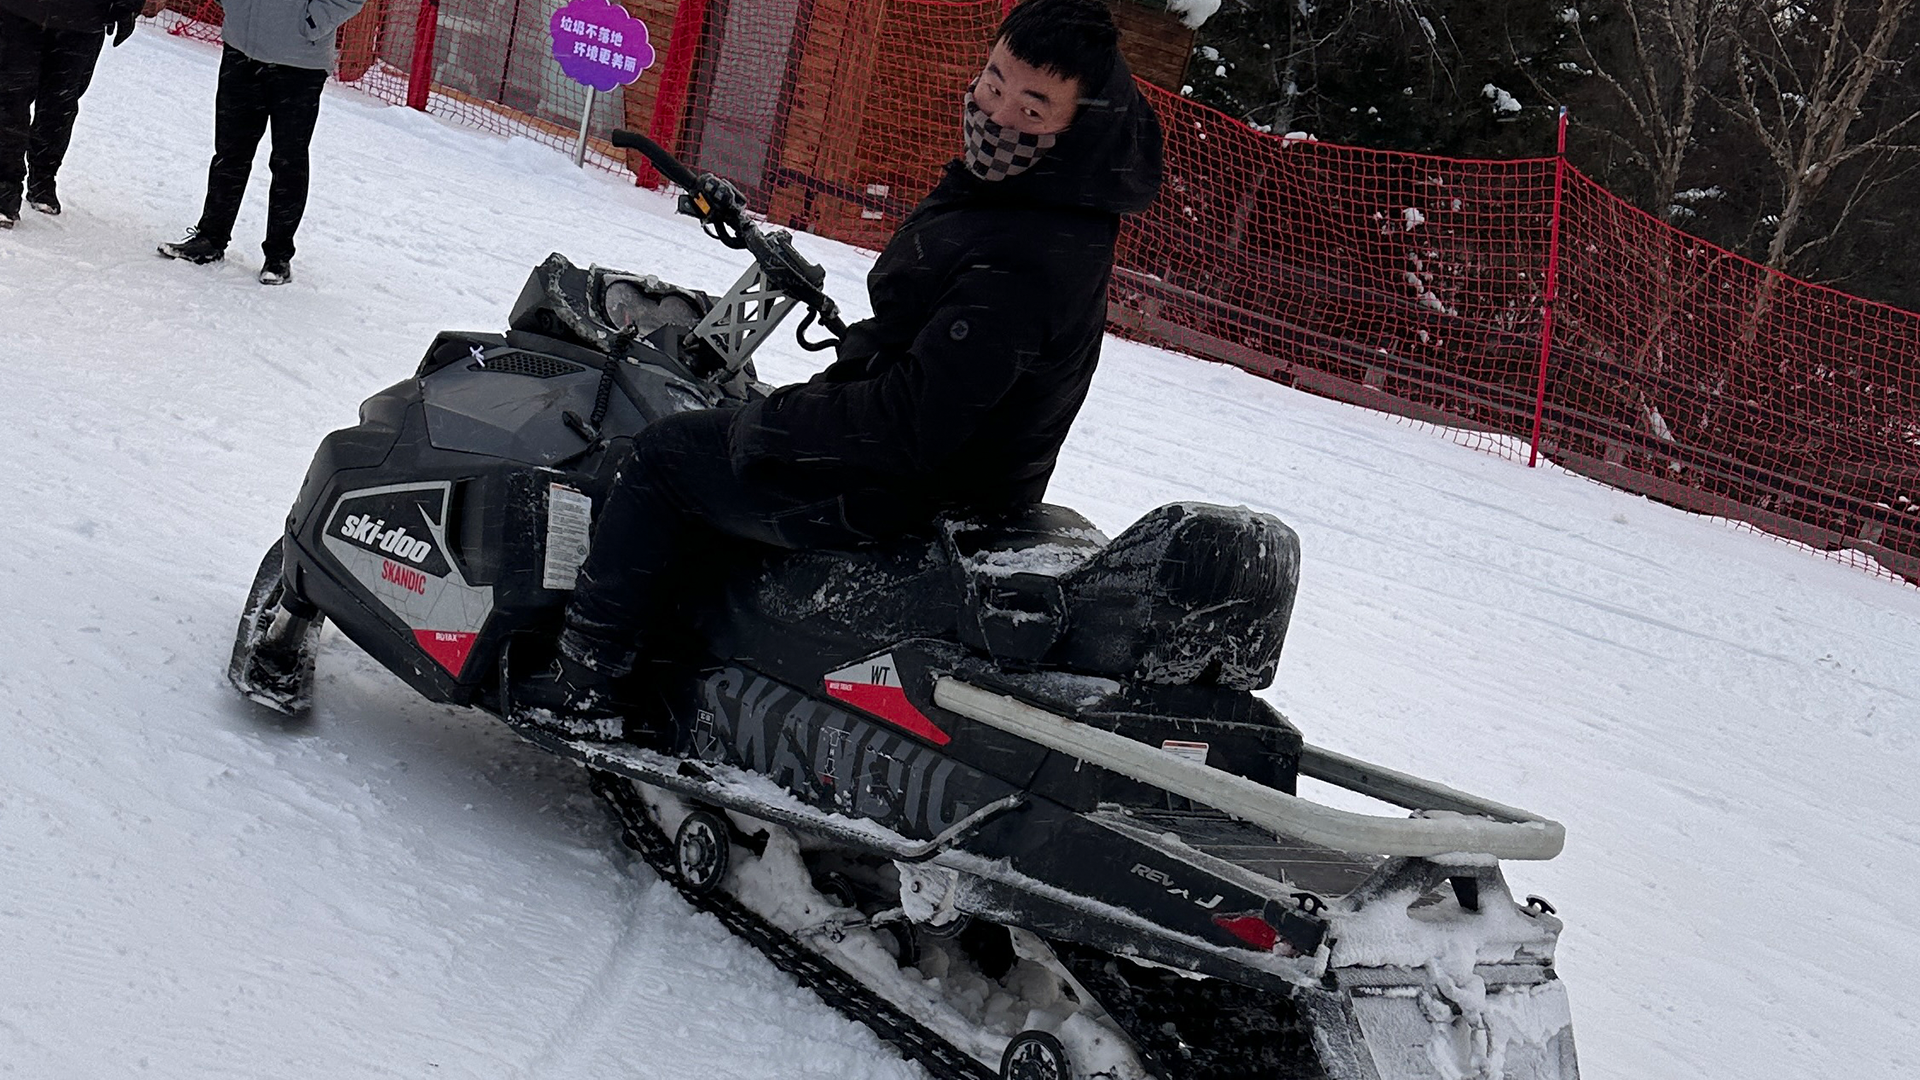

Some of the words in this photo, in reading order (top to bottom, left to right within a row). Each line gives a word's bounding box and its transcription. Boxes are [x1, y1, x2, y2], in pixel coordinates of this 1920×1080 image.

[560, 16, 624, 47] 垃圾不落地
[573, 41, 637, 73] 环境更美丽
[341, 514, 432, 563] ski-doo
[381, 560, 426, 595] SKANDIC
[871, 665, 891, 686] WT
[1130, 863, 1175, 887] REV
